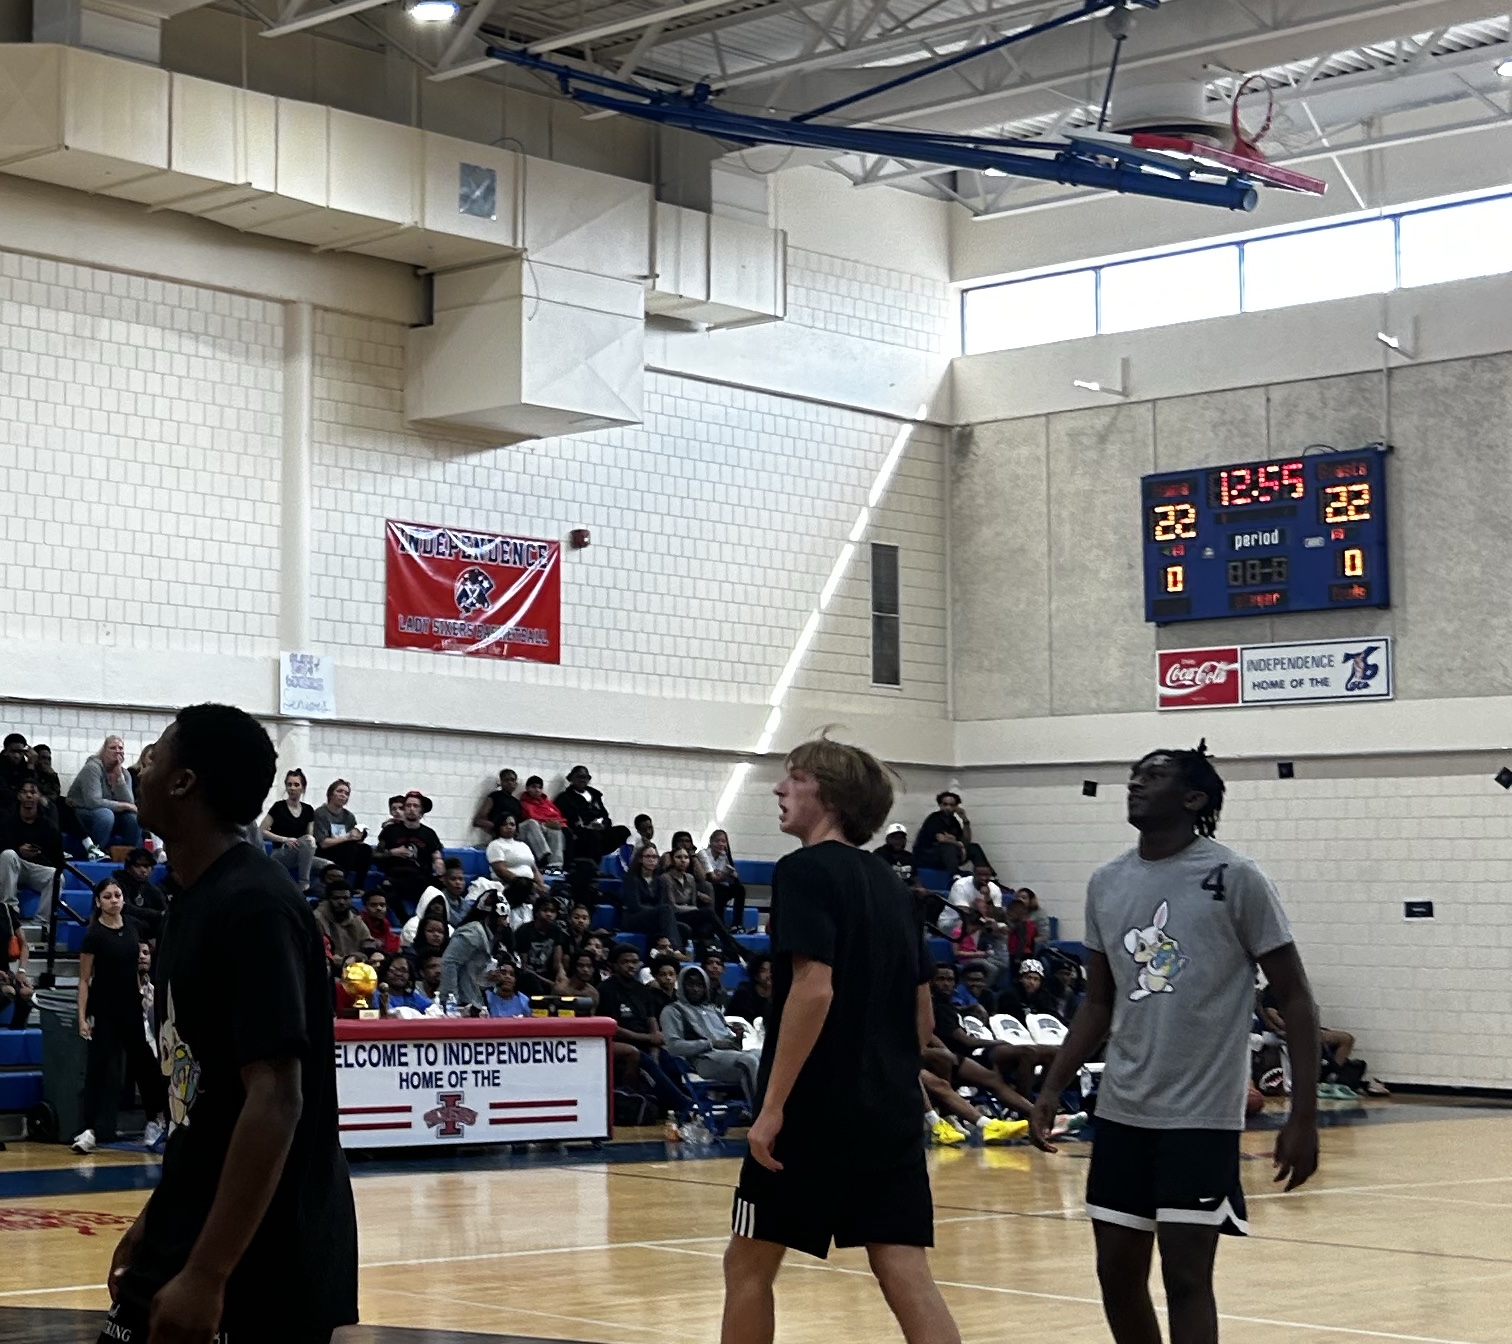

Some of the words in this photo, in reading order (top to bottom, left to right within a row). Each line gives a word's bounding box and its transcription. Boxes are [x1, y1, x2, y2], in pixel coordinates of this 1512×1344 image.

[1325, 483, 1371, 524] 22
[1153, 503, 1197, 542] 22
[399, 528, 549, 571] INDEPENDENCE
[1234, 529, 1280, 551] period
[1344, 548, 1364, 577] 0
[1166, 565, 1184, 593] 0
[398, 614, 430, 635] LADY
[432, 618, 474, 638] SIXERS
[475, 623, 549, 646] BASETBALL
[1246, 654, 1335, 673] INDEPENDENCE
[1252, 679, 1286, 691] HOME
[1290, 678, 1306, 689] OF
[1310, 677, 1331, 688] THE
[1201, 863, 1228, 901] 4
[335, 1043, 408, 1068] ELCOME
[413, 1042, 438, 1067] TO
[444, 1040, 577, 1066] INDEPENDENCE
[399, 1071, 443, 1089] HOME
[448, 1071, 468, 1088] OF
[474, 1069, 501, 1088] THE
